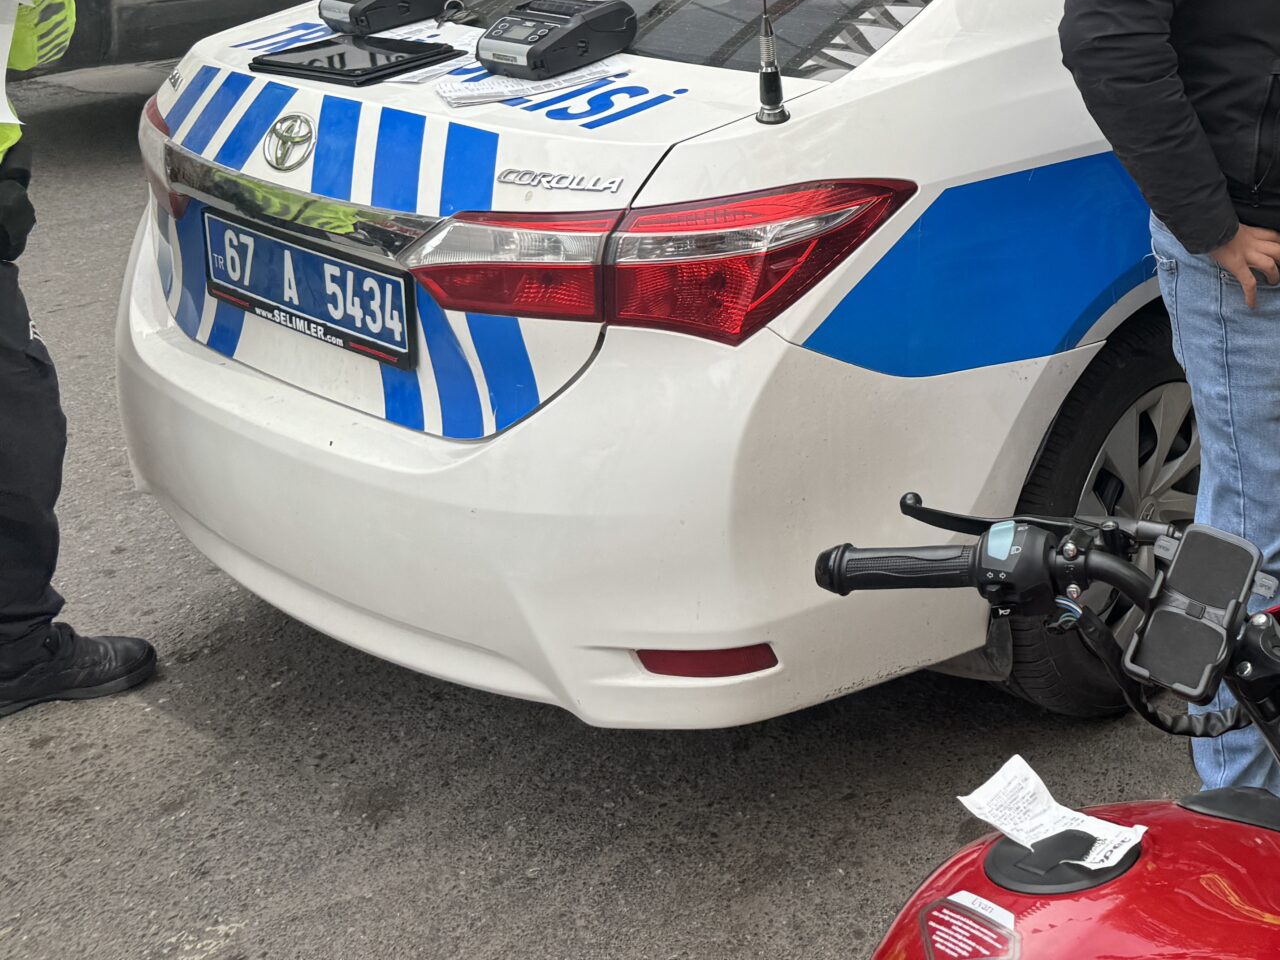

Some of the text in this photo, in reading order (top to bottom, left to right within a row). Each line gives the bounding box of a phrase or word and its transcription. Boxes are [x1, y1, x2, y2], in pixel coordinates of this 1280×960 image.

[496, 168, 624, 194] COROLLA
[213, 229, 403, 342] TR 67 A 5434
